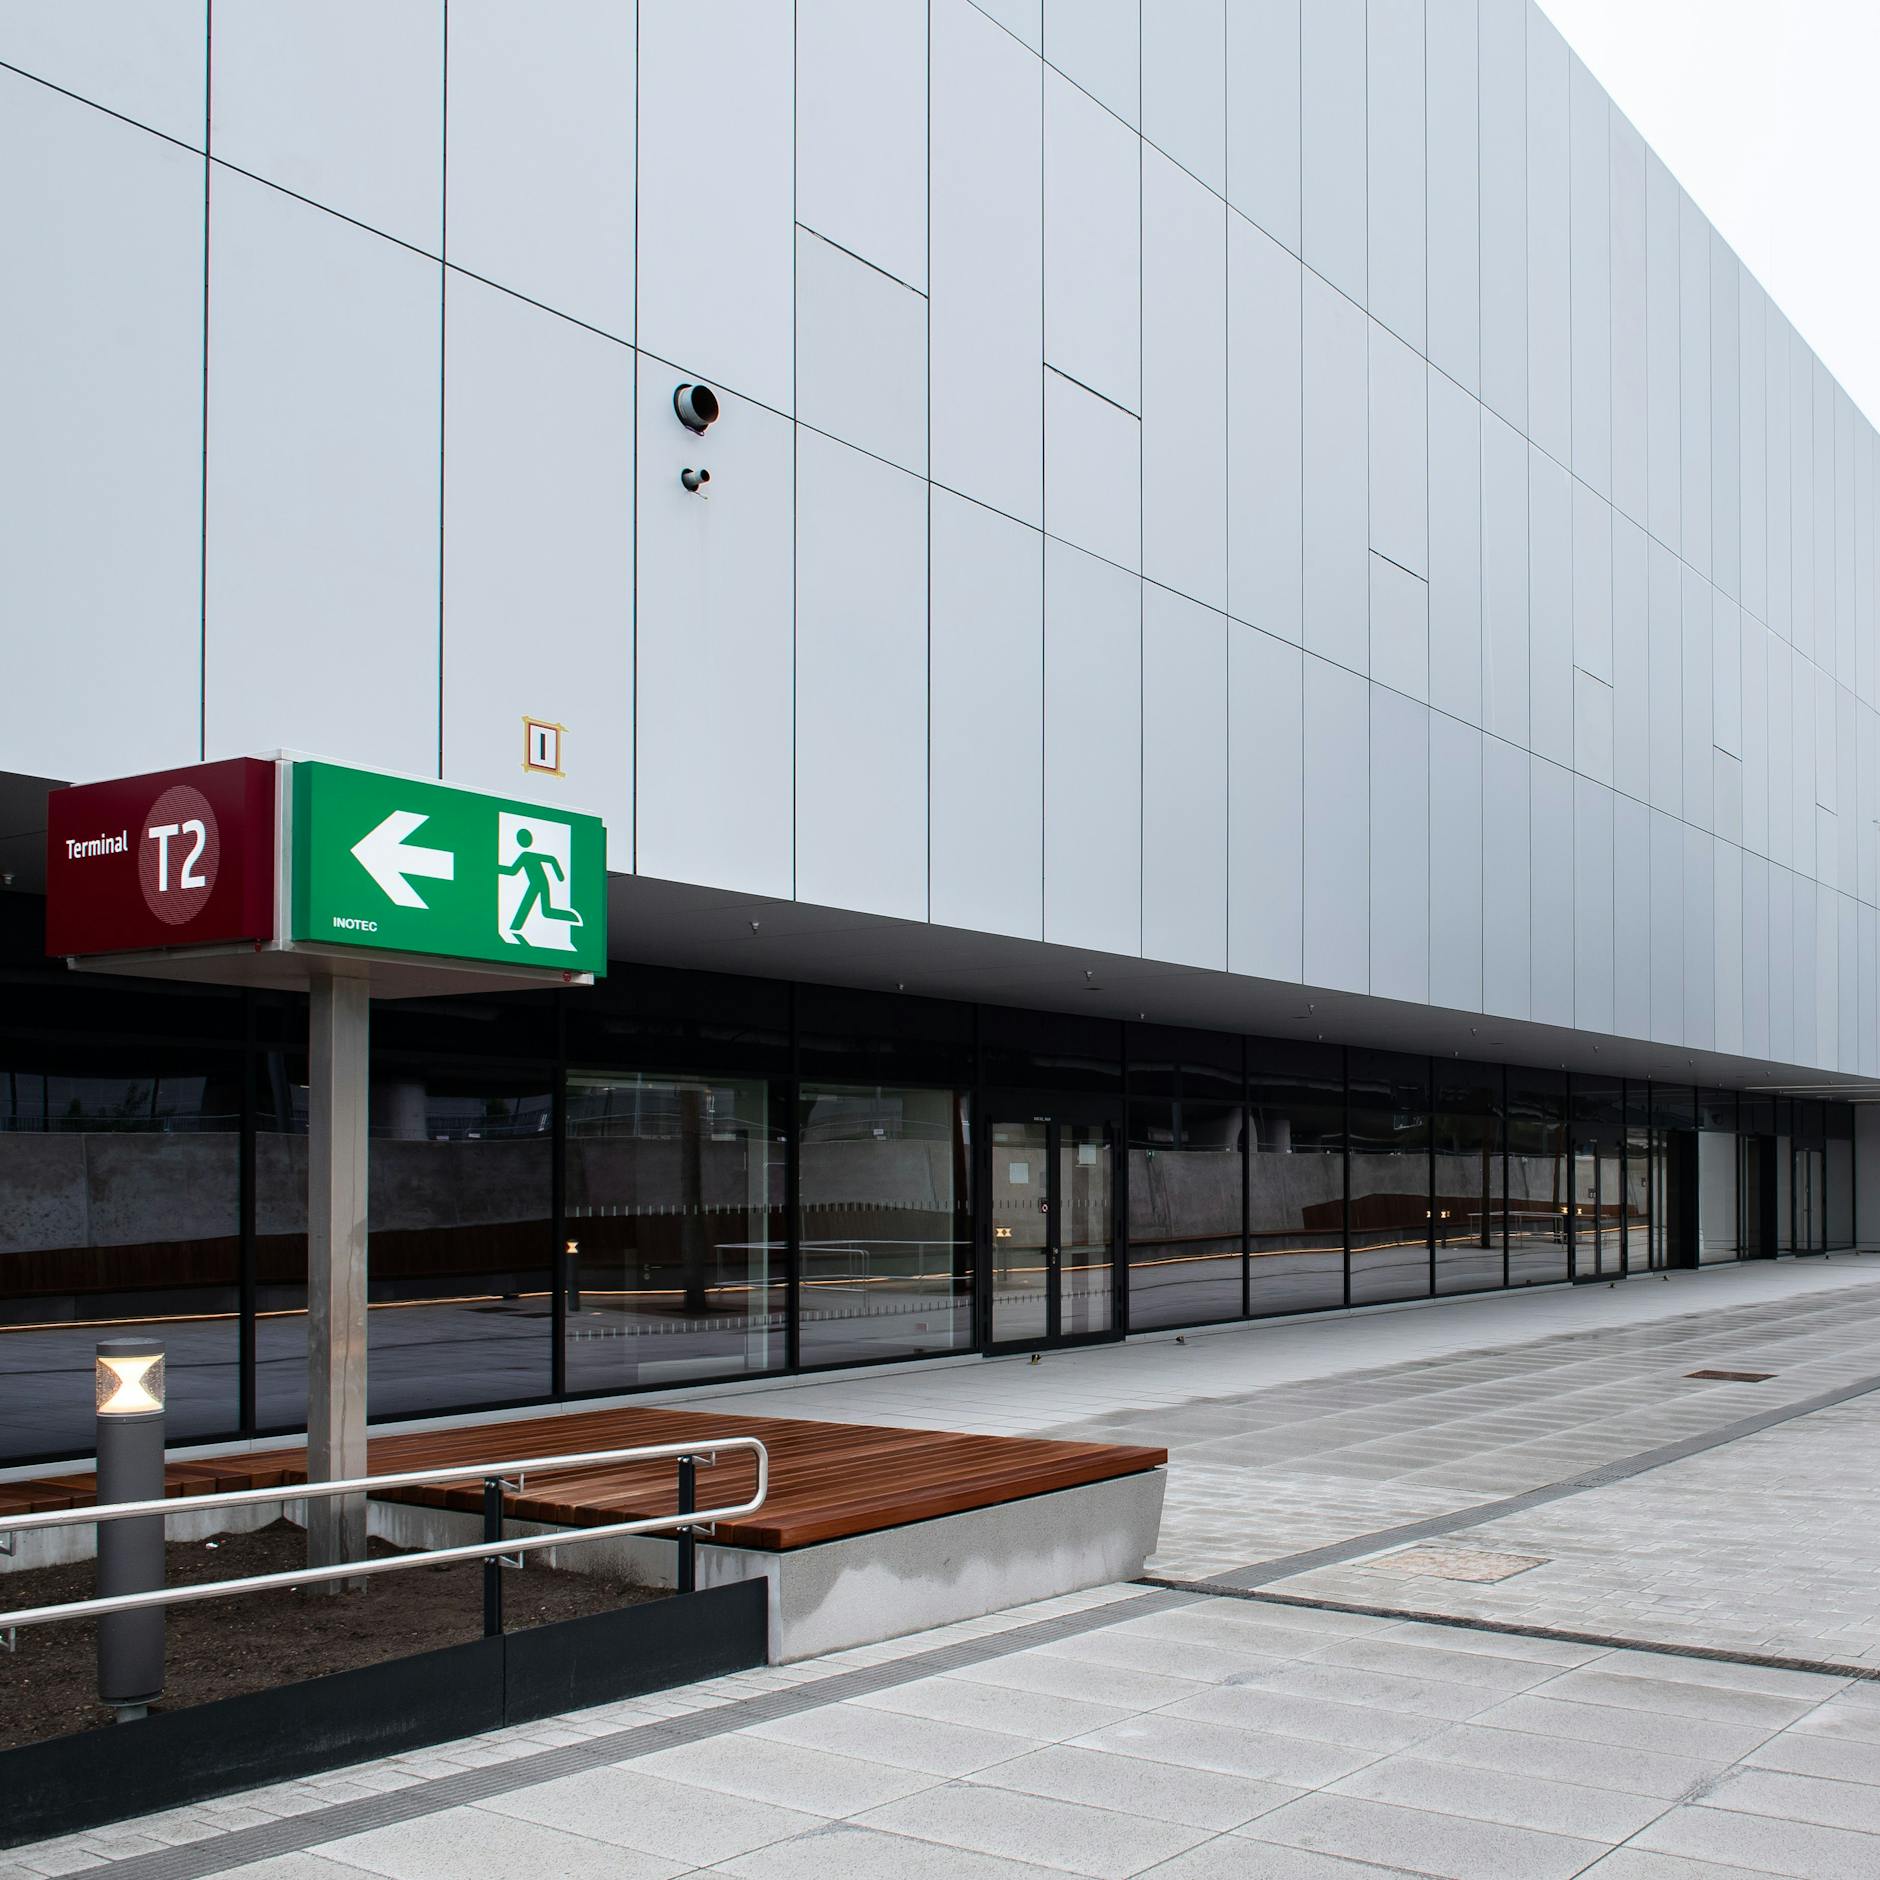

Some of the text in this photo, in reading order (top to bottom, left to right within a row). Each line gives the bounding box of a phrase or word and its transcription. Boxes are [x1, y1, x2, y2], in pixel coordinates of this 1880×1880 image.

[66, 819, 206, 892] Terminal T2
[333, 917, 378, 932] INOTEC
